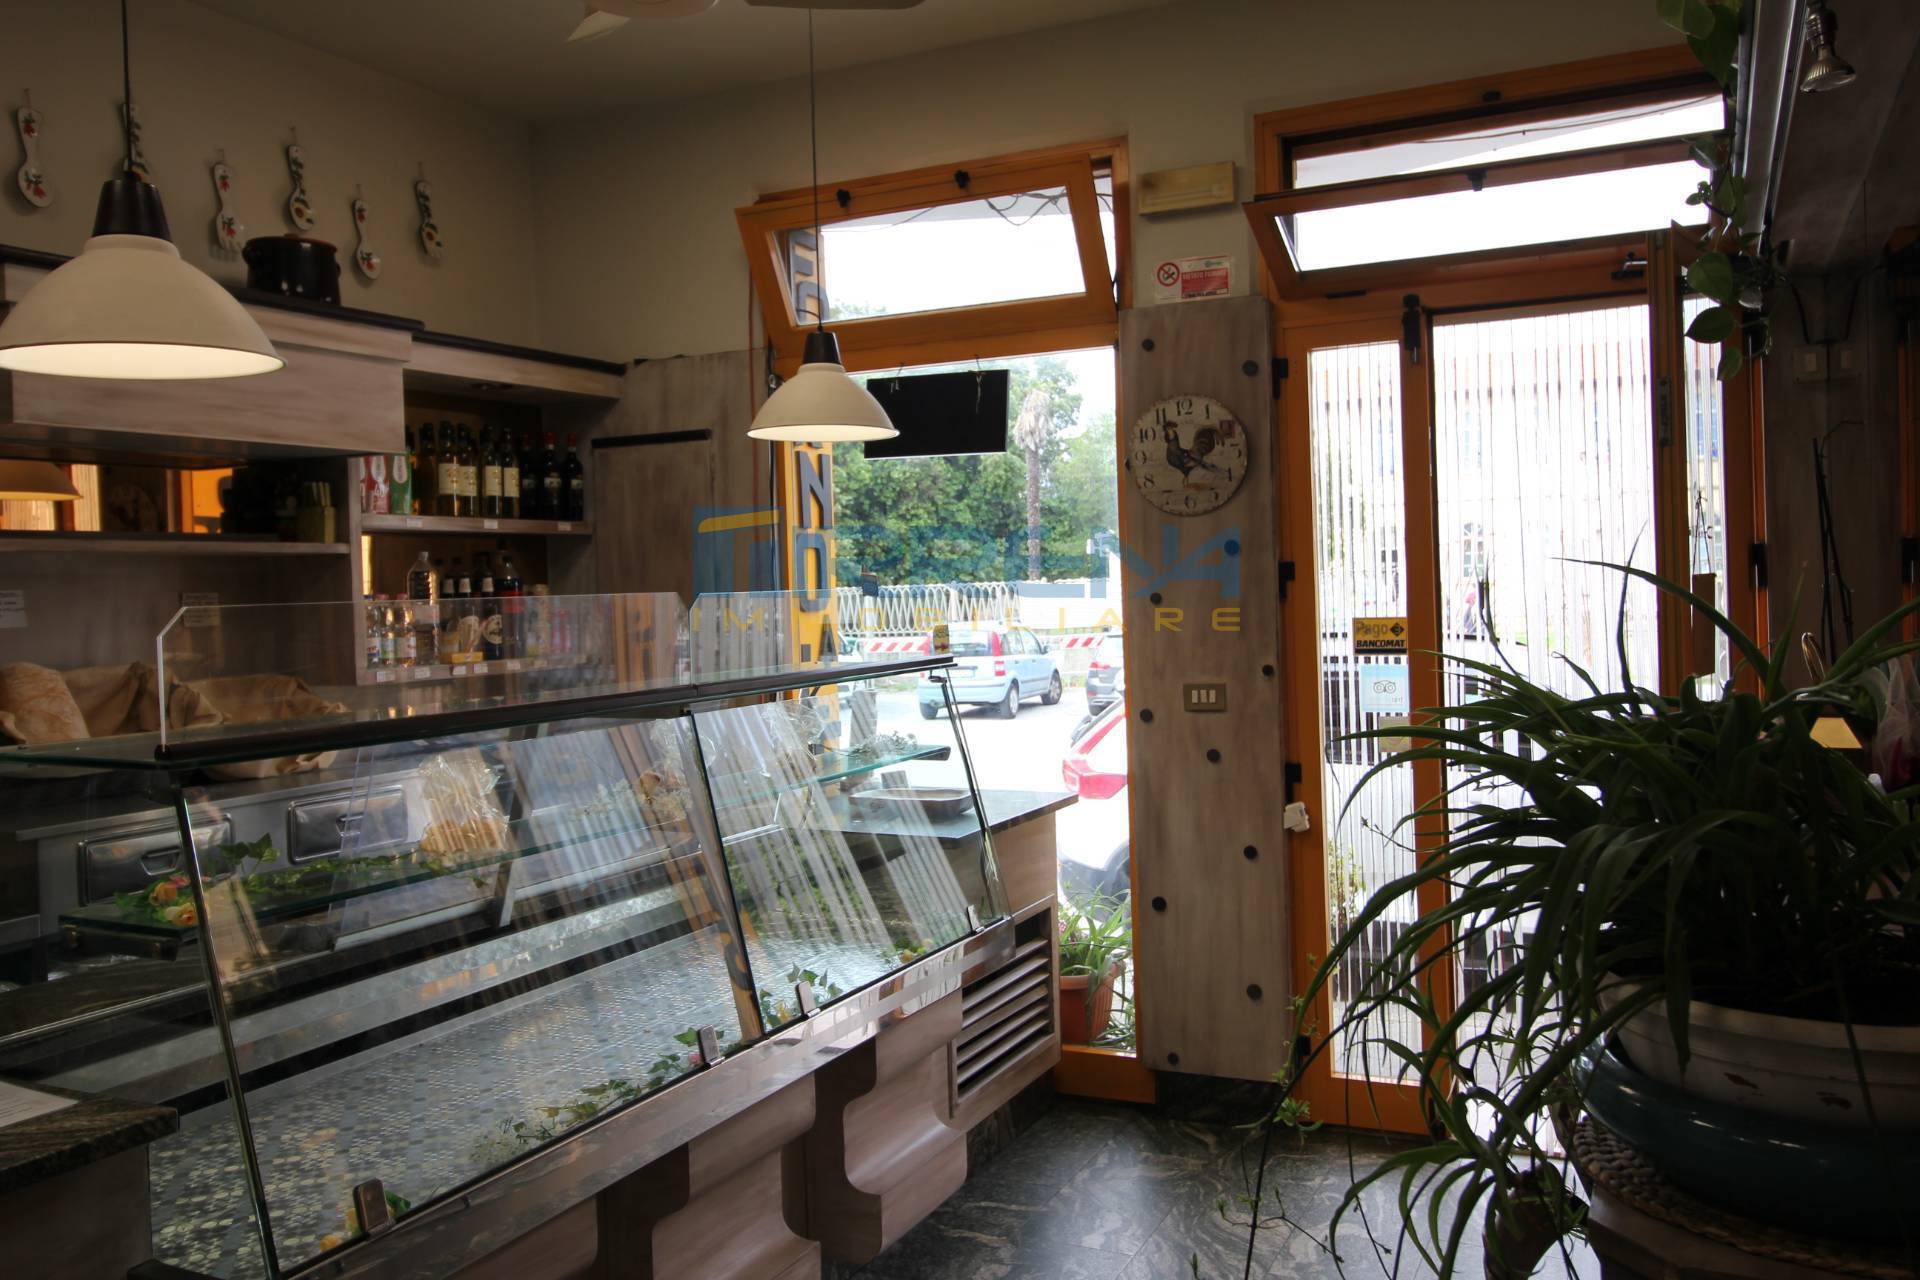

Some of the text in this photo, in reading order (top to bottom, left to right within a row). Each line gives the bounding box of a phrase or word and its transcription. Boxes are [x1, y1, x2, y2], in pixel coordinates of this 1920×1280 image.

[1176, 399, 1194, 416] 12
[1139, 427, 1157, 443] 10
[1355, 621, 1388, 638] Pago
[1355, 639, 1406, 648] BANCOMAT
